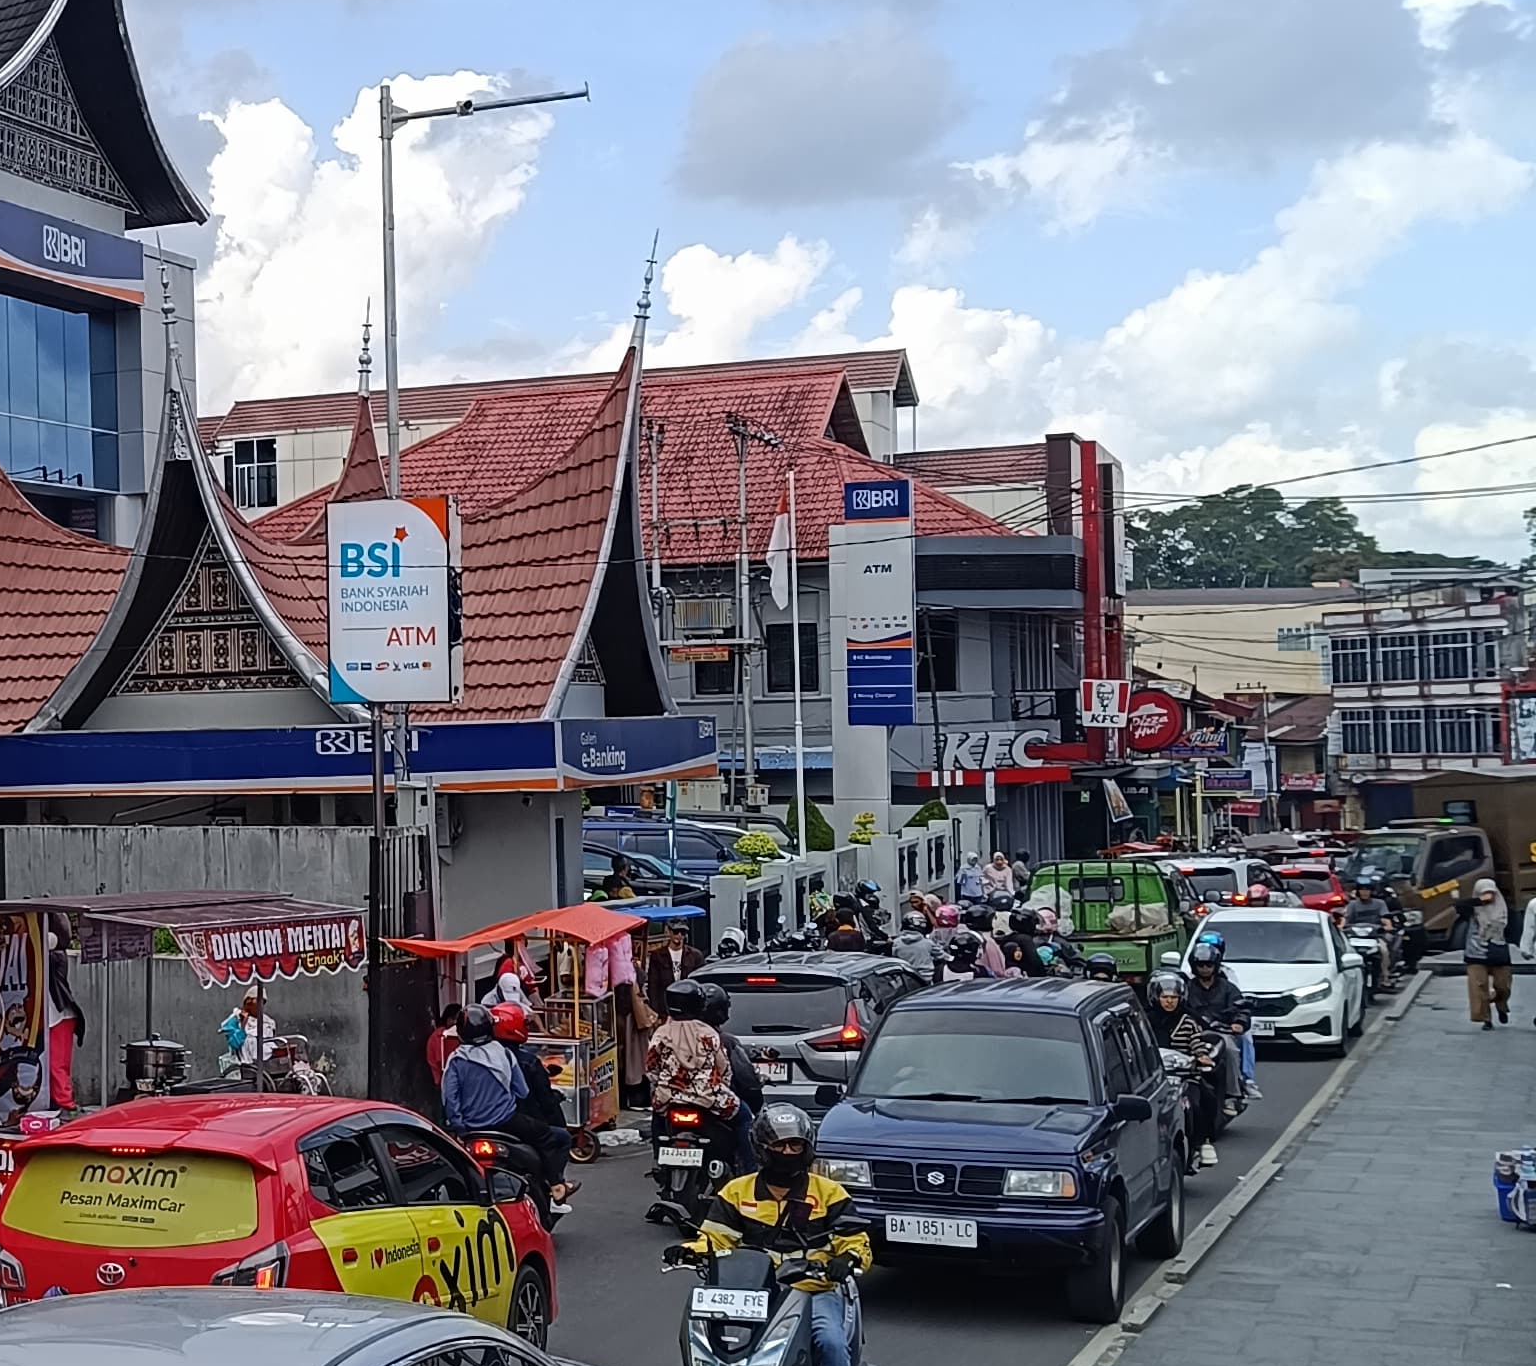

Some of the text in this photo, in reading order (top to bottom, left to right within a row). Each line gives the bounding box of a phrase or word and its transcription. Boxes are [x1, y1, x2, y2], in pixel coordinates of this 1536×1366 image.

[60, 232, 86, 268] BRI
[872, 489, 899, 508] BRI
[340, 541, 401, 578] BSI
[863, 564, 893, 574] ATM
[341, 585, 429, 599] BANK SYARIAH
[341, 600, 409, 613] INDONESIA
[386, 626, 437, 647] ATM
[1089, 713, 1120, 724] KFC
[582, 746, 626, 771] e-Banking
[942, 728, 1050, 771] KFC
[211, 922, 346, 961] DINSUM MENTAI
[79, 1161, 179, 1189] maxim
[60, 1190, 186, 1214] Pesan MaximCar
[890, 1217, 973, 1238] BA 1851 LC
[696, 1289, 765, 1309] B 4382 FYE
